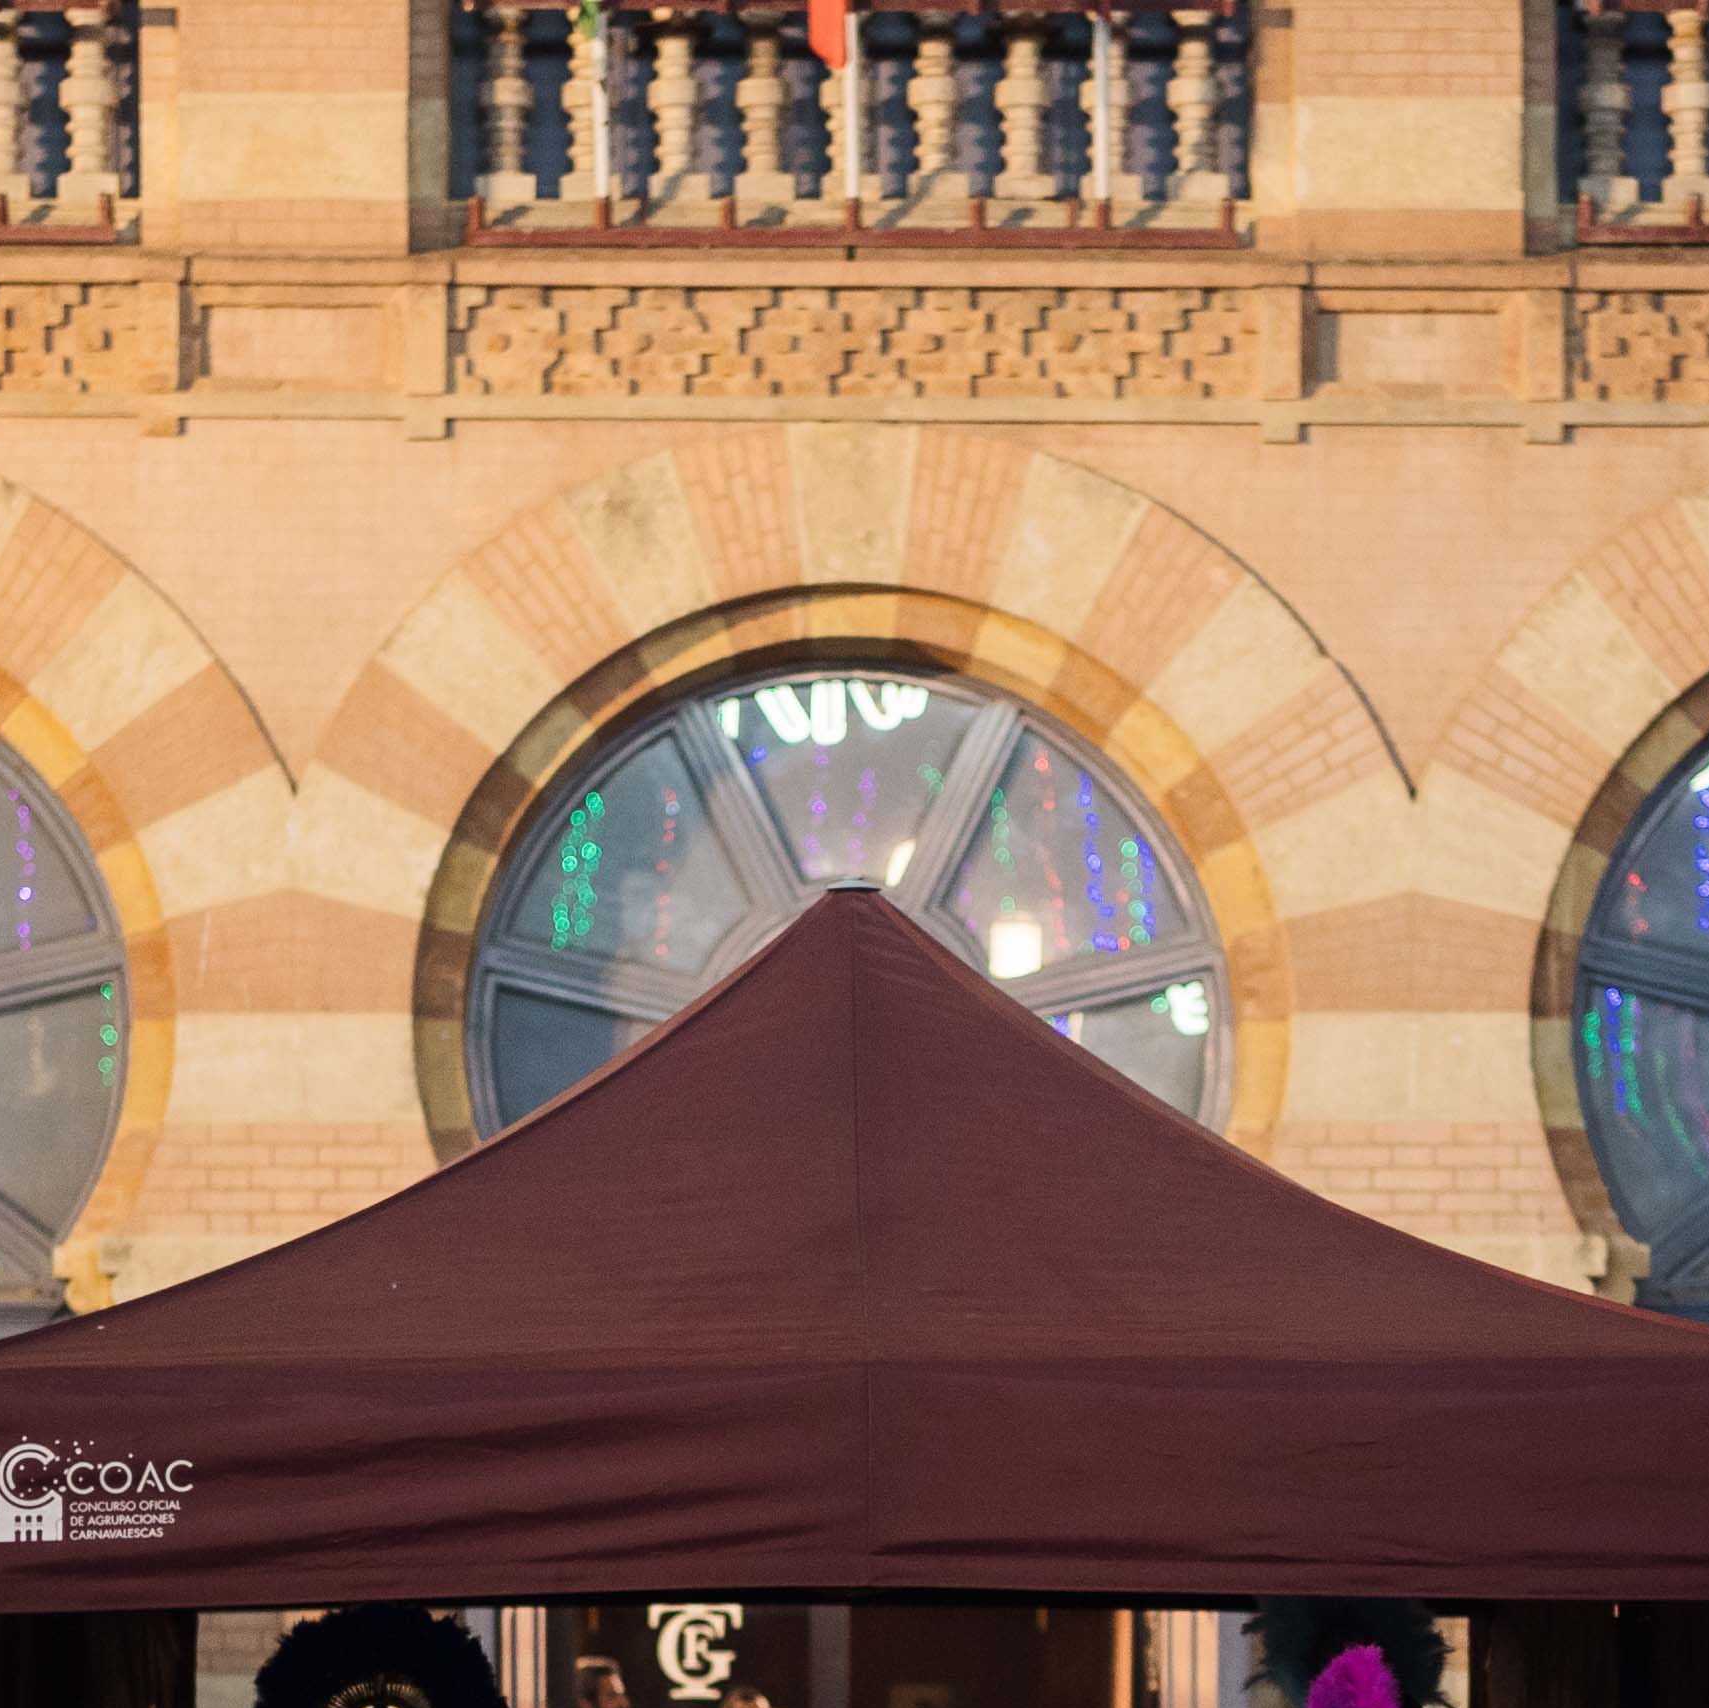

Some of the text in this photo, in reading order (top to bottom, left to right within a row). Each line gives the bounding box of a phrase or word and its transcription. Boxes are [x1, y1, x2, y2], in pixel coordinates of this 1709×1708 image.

[65, 1459, 194, 1495] COAC
[69, 1499, 181, 1513] CONCURSO OFICIAL
[70, 1513, 175, 1527] DE AGRUPACIONES
[69, 1527, 164, 1541] CARNAVALESCAS
